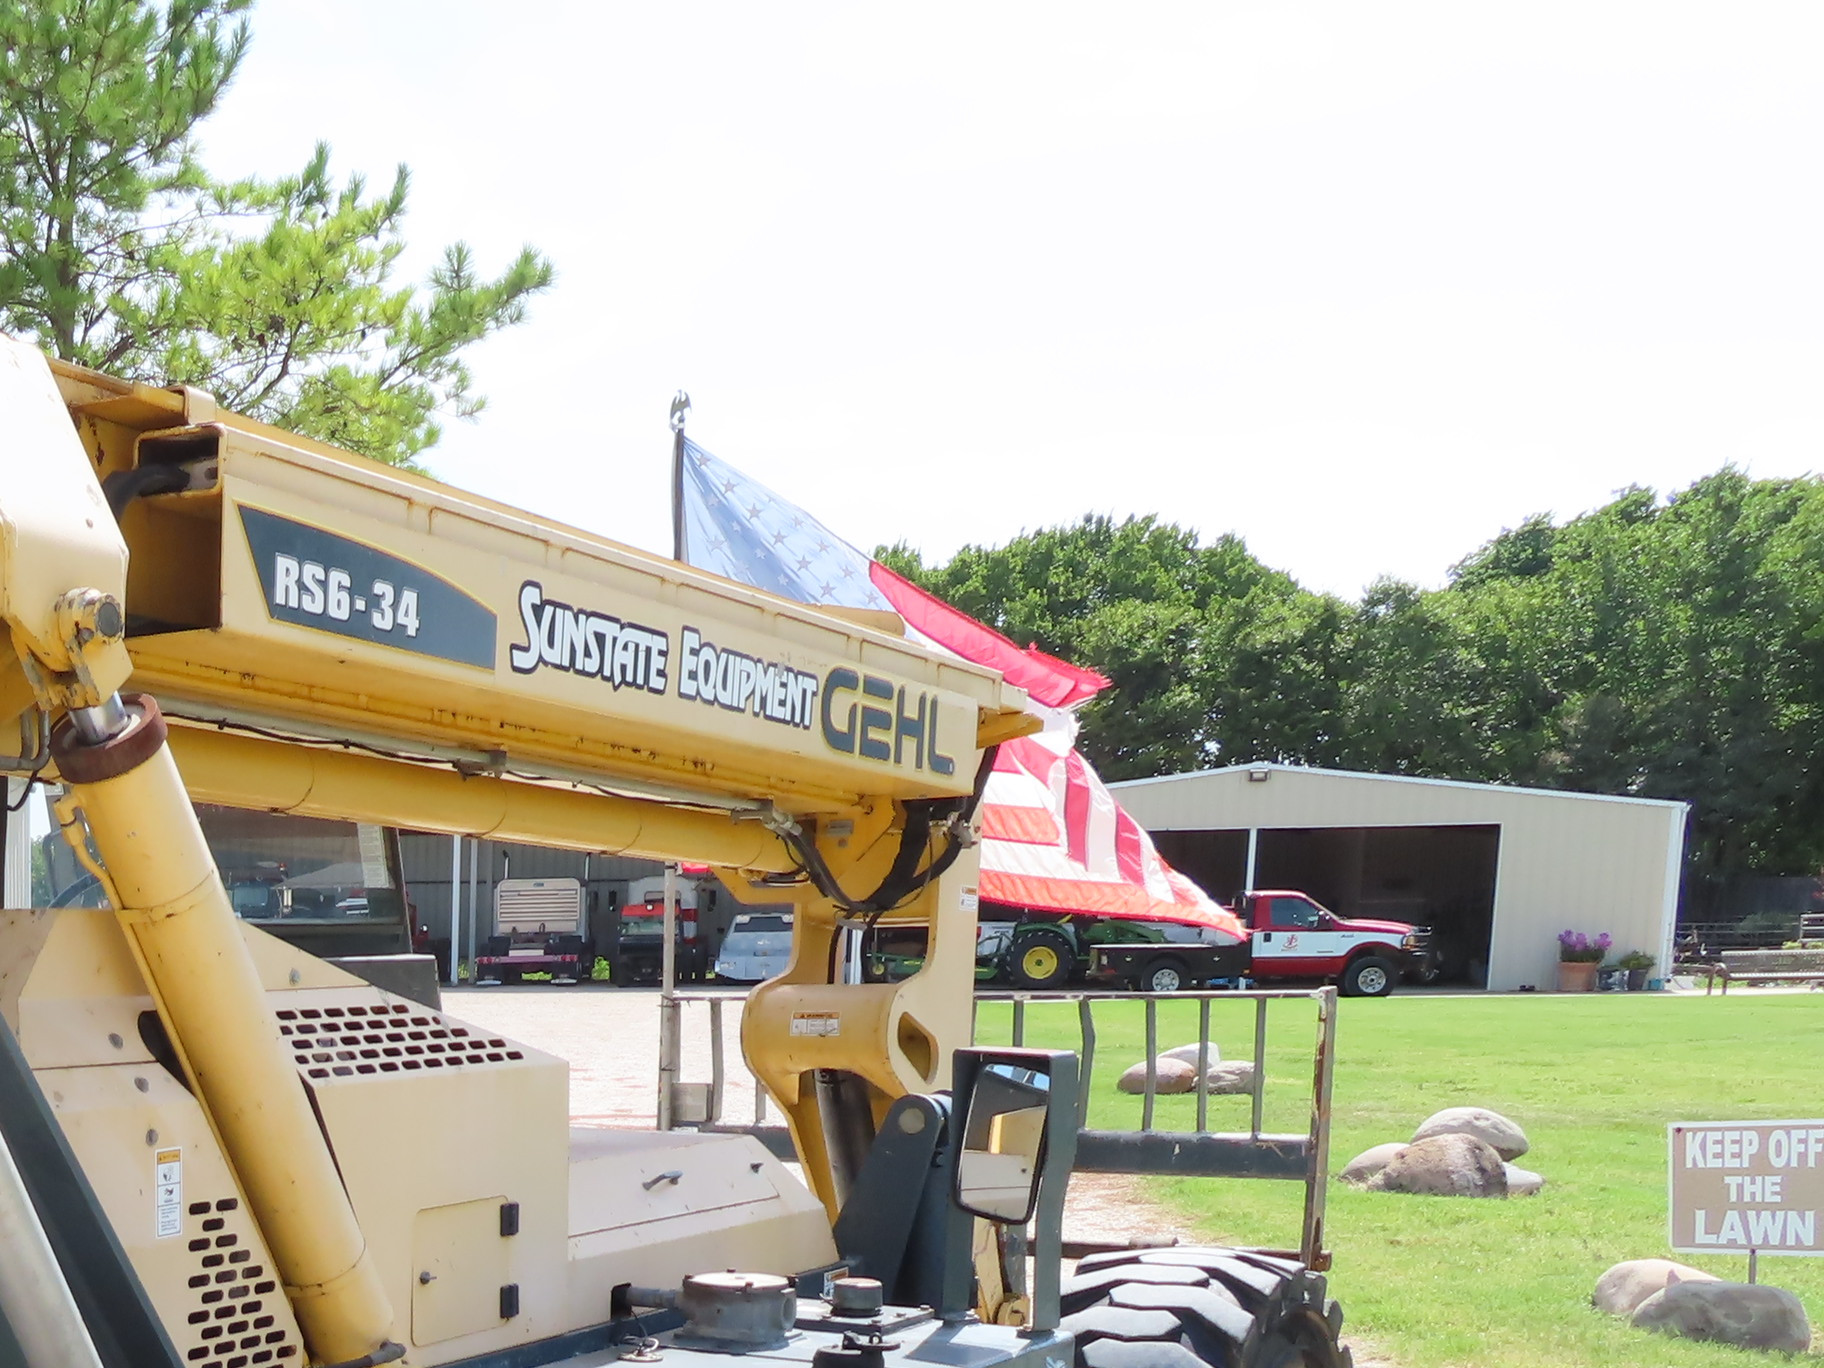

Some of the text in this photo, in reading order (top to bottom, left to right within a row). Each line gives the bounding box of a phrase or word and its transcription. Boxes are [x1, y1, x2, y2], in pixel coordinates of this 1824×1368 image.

[274, 552, 420, 638] RS6-34
[509, 580, 819, 730] SUNSTATE EQUIPMENT
[822, 667, 955, 776] GEHL
[1685, 1128, 1824, 1169] KEEP OFF
[1723, 1175, 1782, 1203] THE
[1694, 1209, 1816, 1247] LAWN
